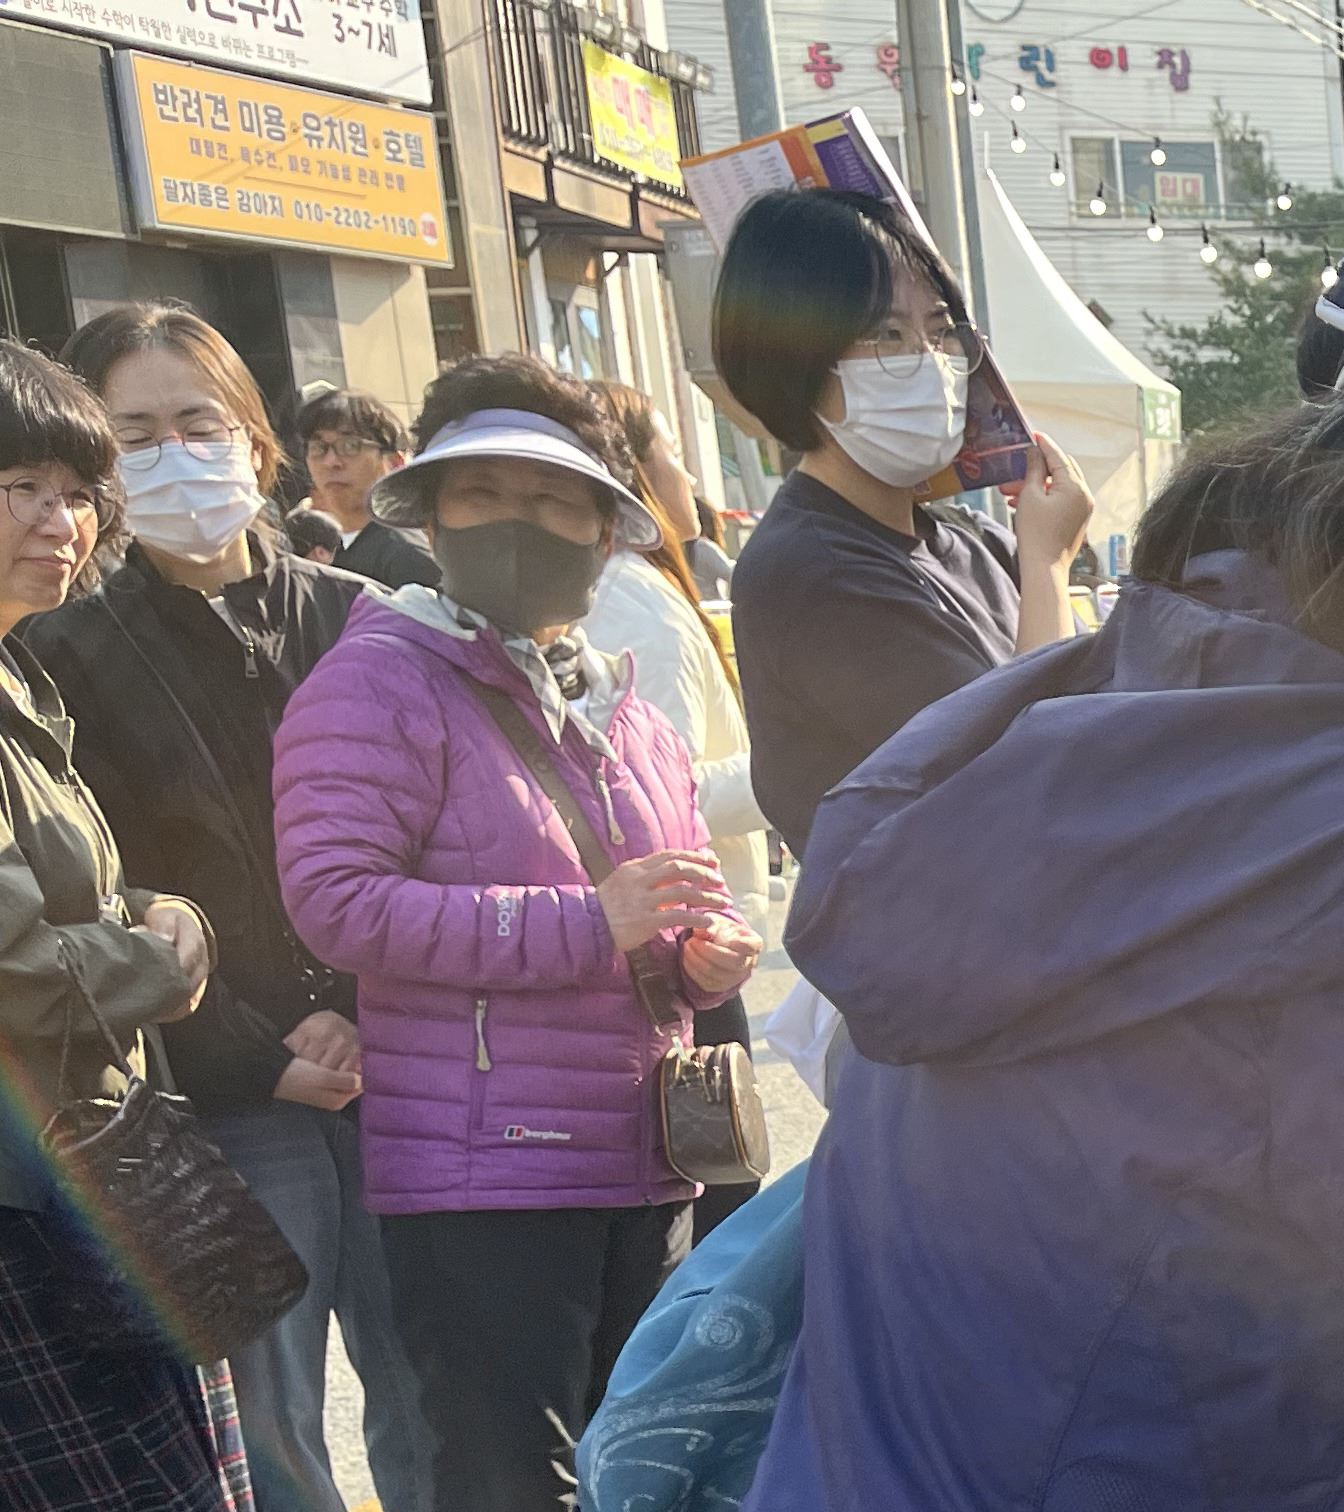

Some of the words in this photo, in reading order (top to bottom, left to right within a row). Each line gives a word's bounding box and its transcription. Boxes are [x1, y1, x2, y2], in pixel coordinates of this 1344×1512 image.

[332, 12, 398, 57] 3~7세
[152, 82, 230, 132] 반려견
[238, 100, 286, 142] 미용
[302, 112, 369, 157] 유치원
[383, 128, 426, 168] 호텔
[162, 178, 230, 210] 팔자좋은
[1159, 176, 1202, 198] 임대
